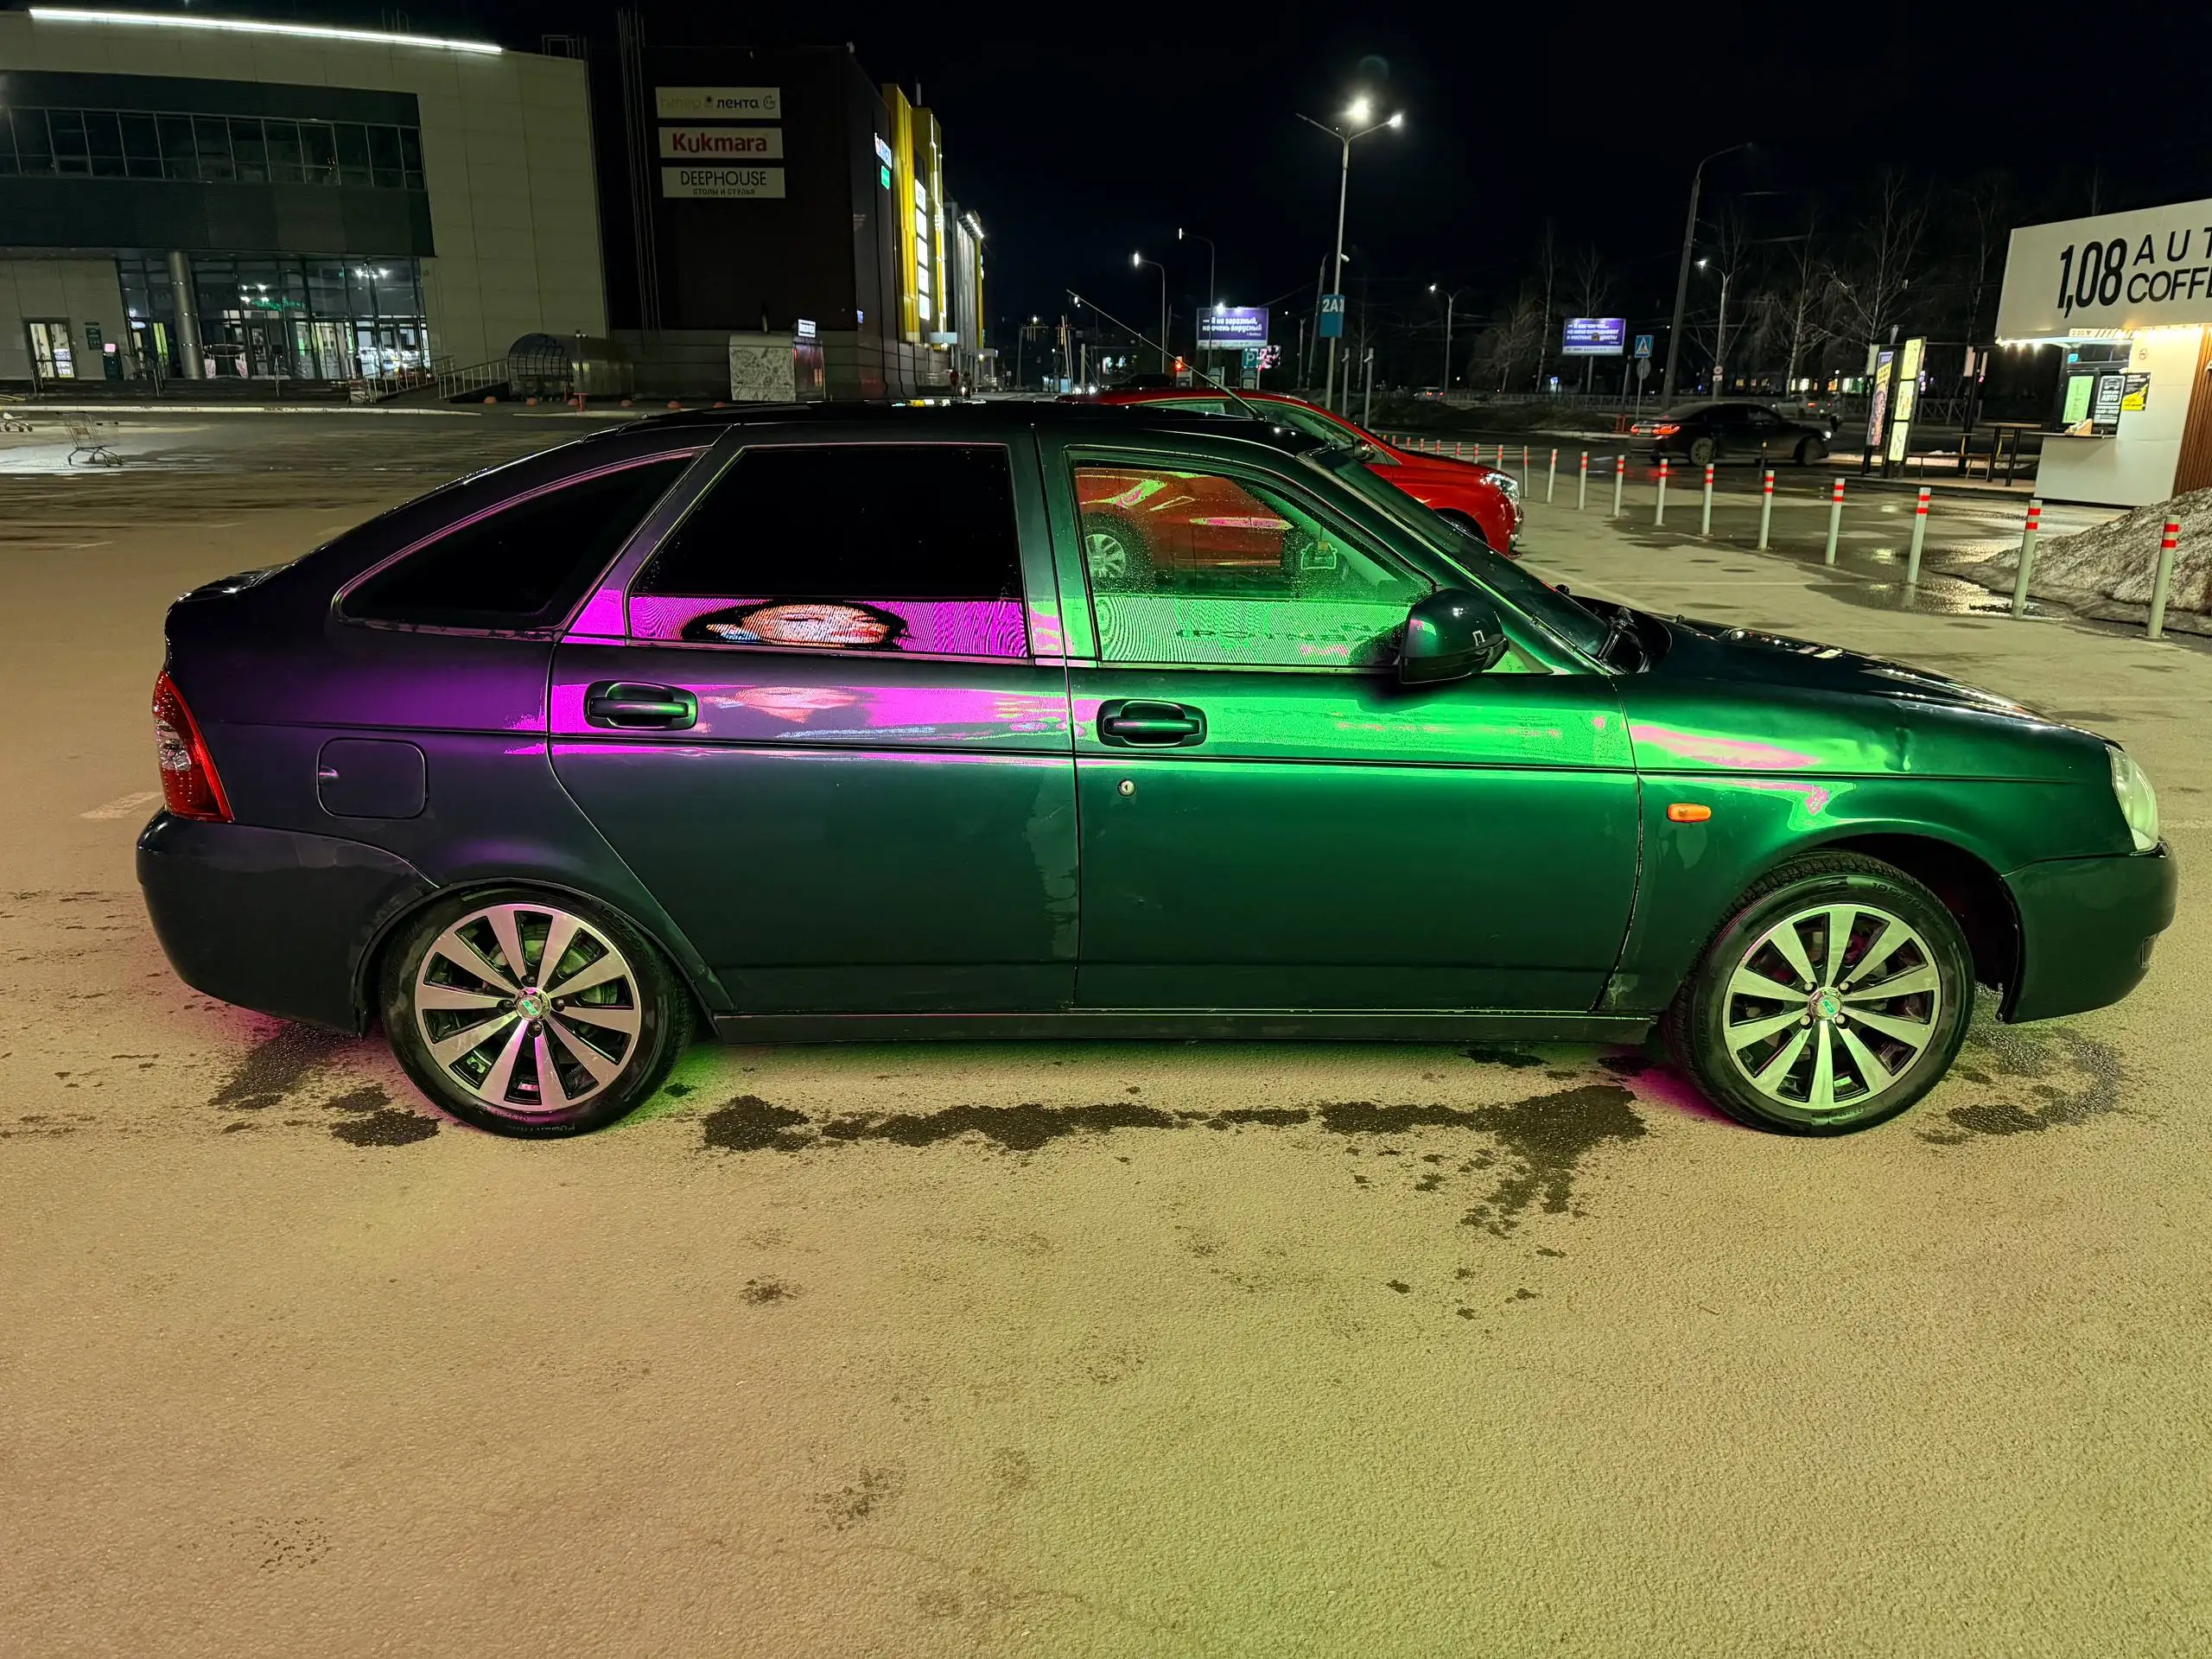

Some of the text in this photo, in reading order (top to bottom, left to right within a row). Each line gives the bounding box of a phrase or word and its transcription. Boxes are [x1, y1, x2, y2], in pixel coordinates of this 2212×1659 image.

[716, 99, 760, 109] лента
[672, 132, 767, 153] Kukmara
[680, 170, 767, 186] DEEPHOUSE
[2057, 238, 2127, 319] 1,08
